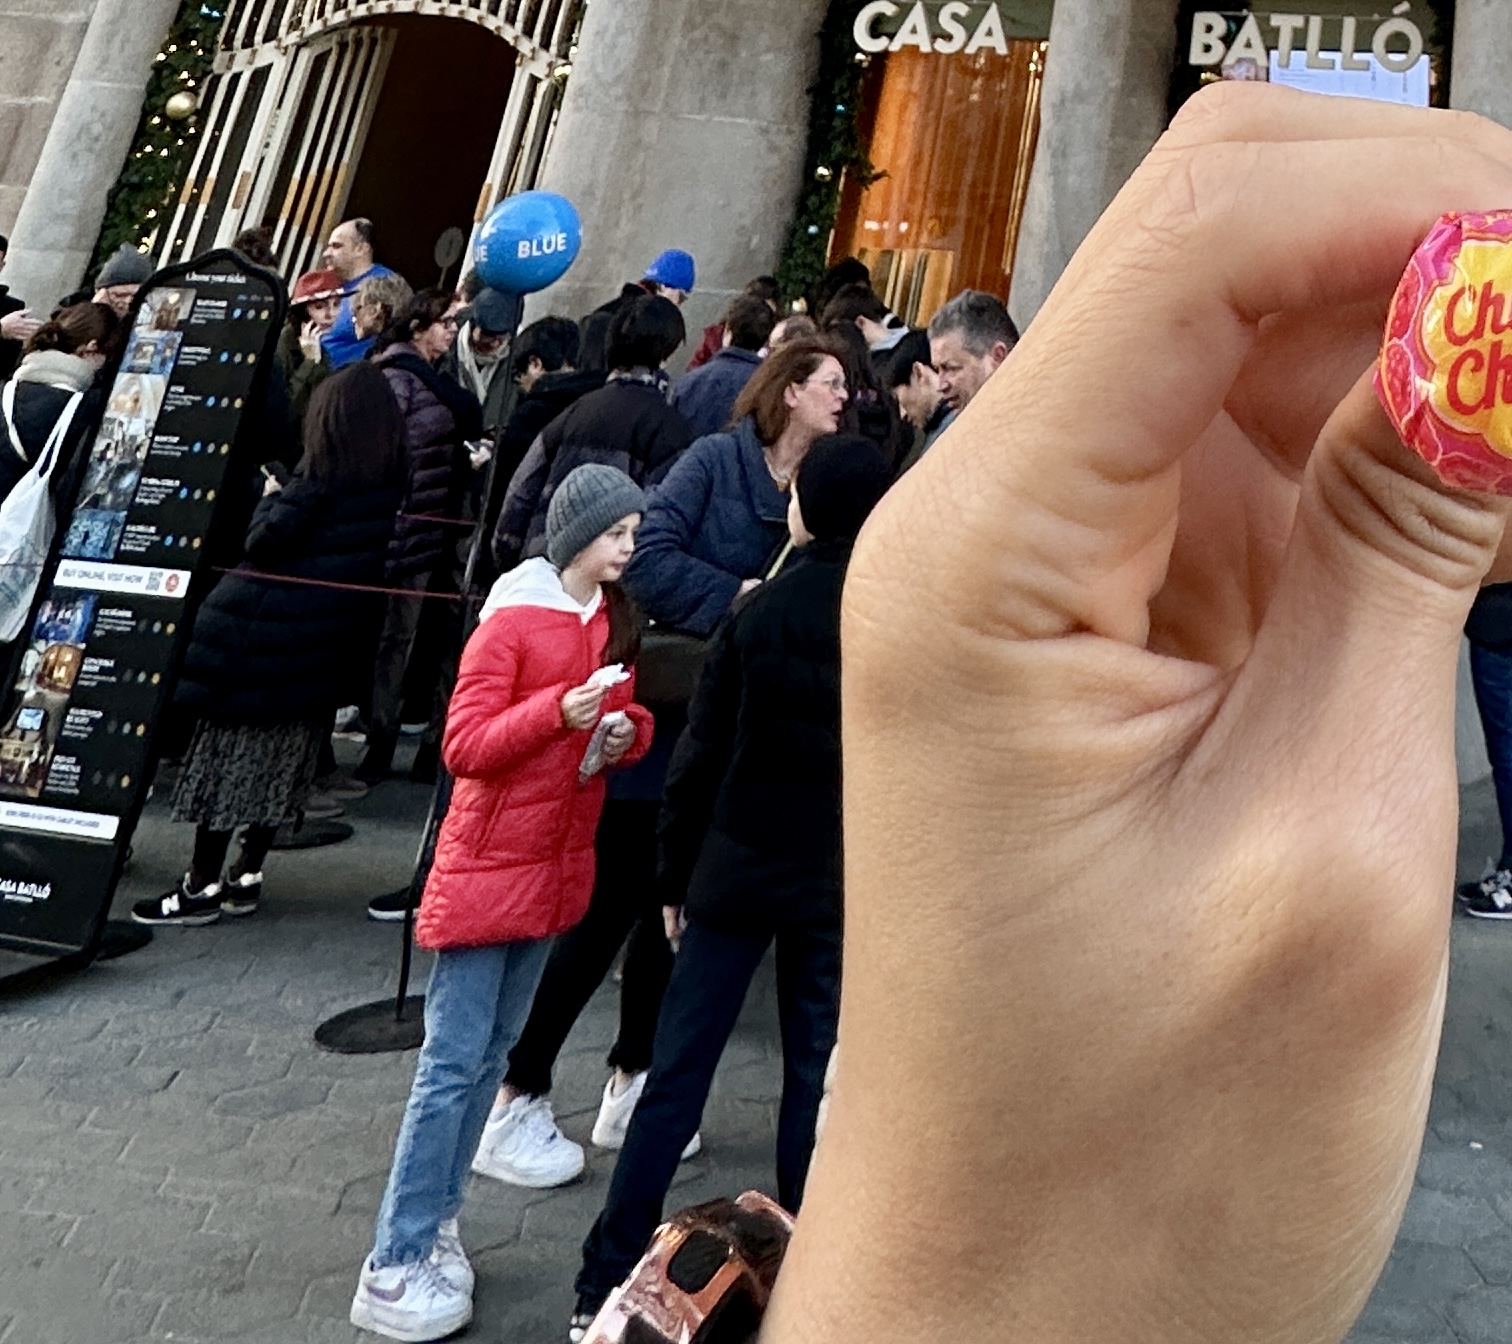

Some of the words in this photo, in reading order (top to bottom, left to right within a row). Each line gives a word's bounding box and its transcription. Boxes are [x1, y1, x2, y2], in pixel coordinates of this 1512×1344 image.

[853, 0, 1009, 55] CASA
[1189, 1, 1424, 73] BATLLÓ
[517, 232, 568, 259] BLUE
